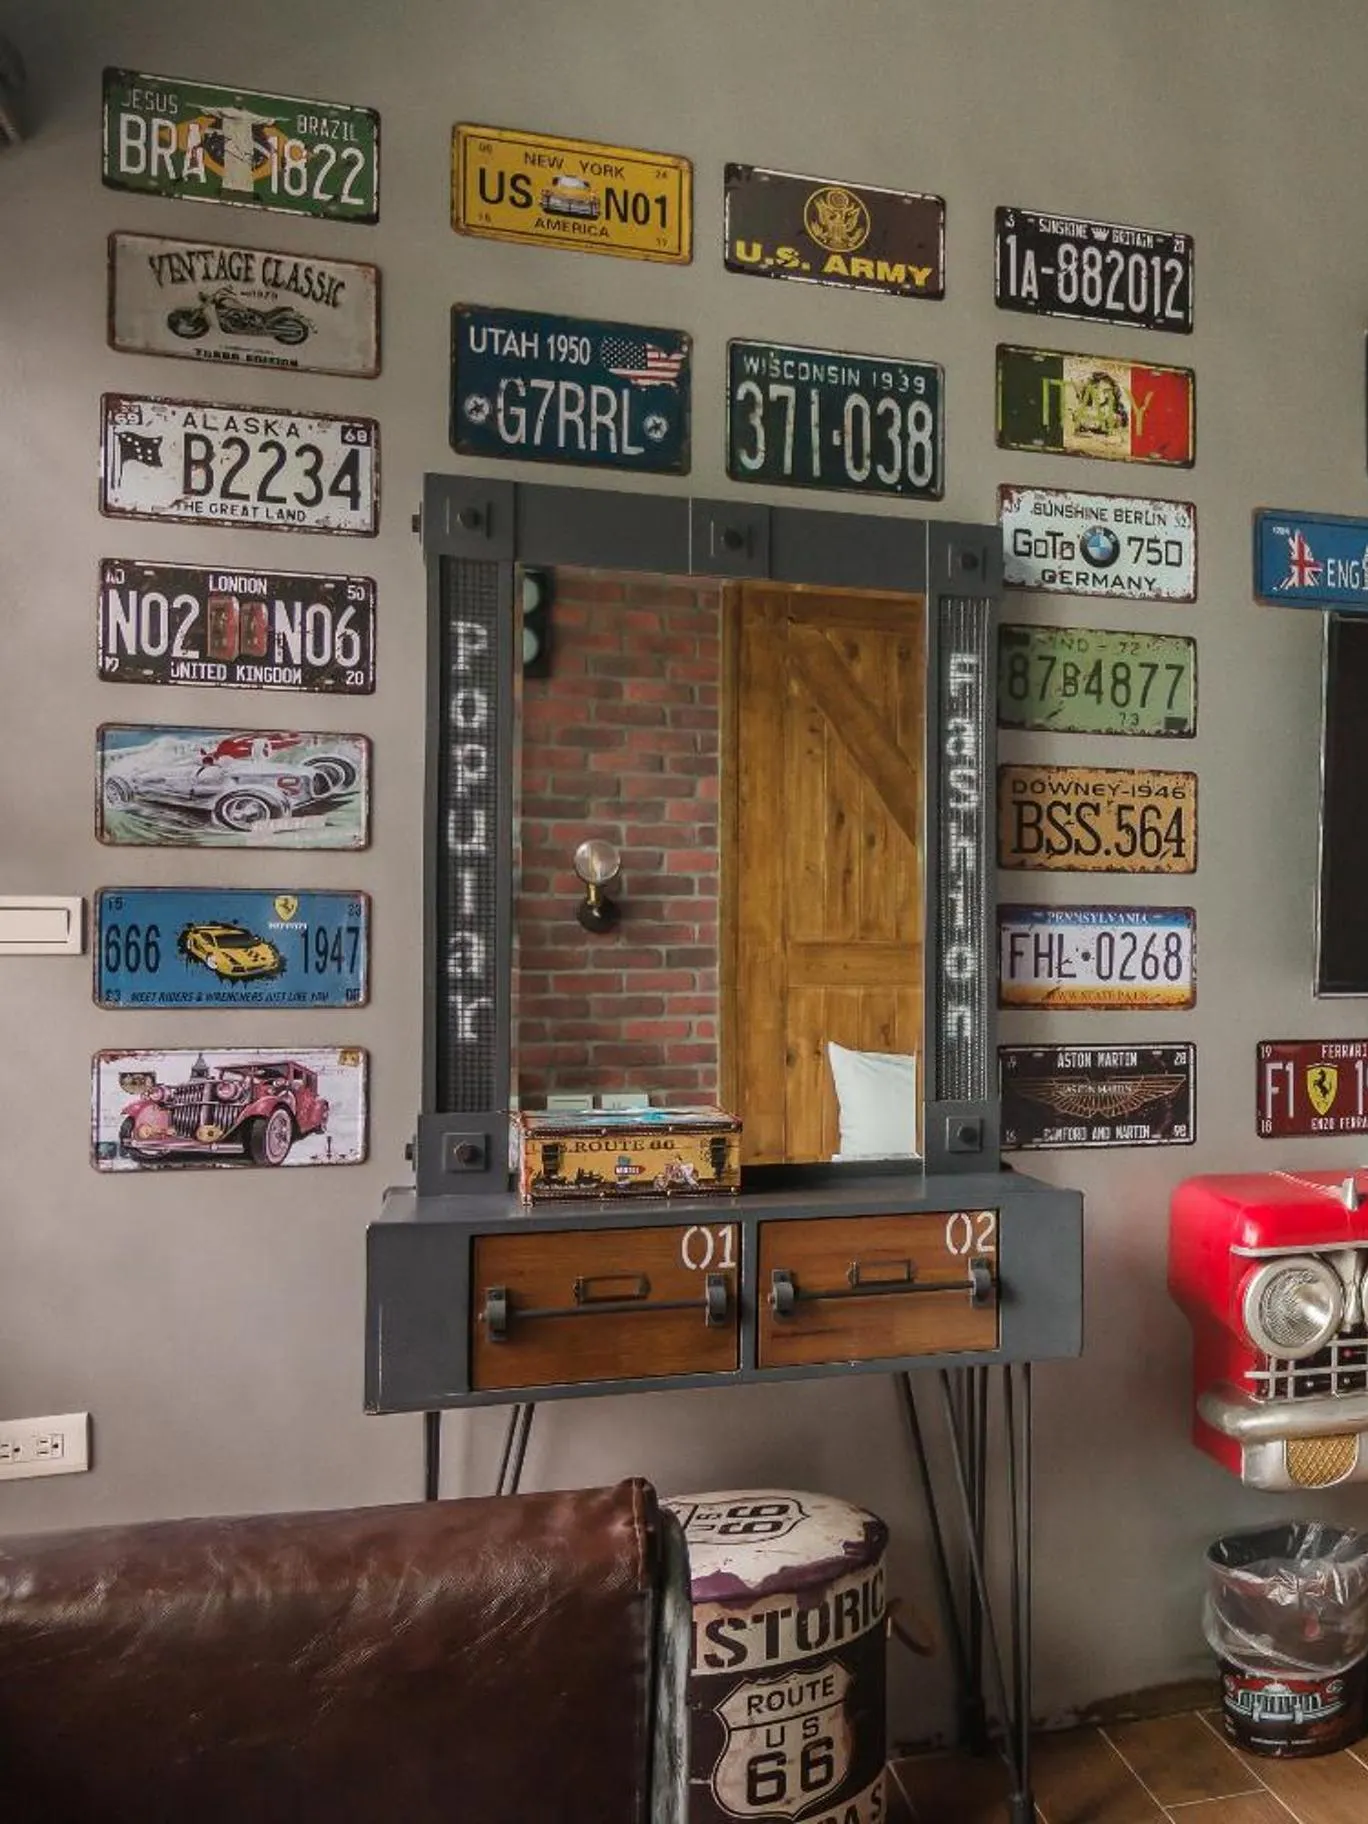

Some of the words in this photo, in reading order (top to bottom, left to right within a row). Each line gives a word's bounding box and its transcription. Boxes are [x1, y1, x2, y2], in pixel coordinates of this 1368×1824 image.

[121, 88, 178, 115] JESUS
[296, 114, 359, 142] BRAZIL
[119, 113, 207, 184] BRA
[523, 151, 565, 171] NEW
[579, 159, 625, 181] YORK
[478, 166, 534, 210] US
[534, 216, 610, 239] AMERICA
[735, 239, 811, 272] U.S.
[822, 251, 934, 287] ARMY
[261, 255, 347, 309] CLASSIC
[469, 325, 539, 361] UTAH
[546, 334, 592, 367] 1950
[743, 356, 861, 388] WISCONSIN
[182, 411, 301, 439] ALASKA
[496, 376, 646, 457] G7RRL
[182, 432, 362, 512] B2234
[209, 502, 259, 519] GREAT
[266, 506, 306, 522] LAND
[1033, 501, 1109, 523] SUNSHINE
[1113, 506, 1168, 527] BERLIN
[208, 574, 268, 596] LONDON
[1041, 567, 1158, 592] GERMANY
[170, 662, 228, 682] UNITED
[236, 664, 303, 685] KINGDOM
[1047, 911, 1149, 925] PENNSYLVANIA
[105, 923, 161, 974] 666
[301, 925, 361, 975] 1947
[1057, 1051, 1092, 1069] ASTON
[1097, 1051, 1138, 1068] MARTIN
[1321, 1043, 1368, 1059] FERRARI
[1115, 1124, 1150, 1140] MARTIN
[746, 1674, 835, 1716] ROUTE
[746, 1735, 834, 1807] 66
